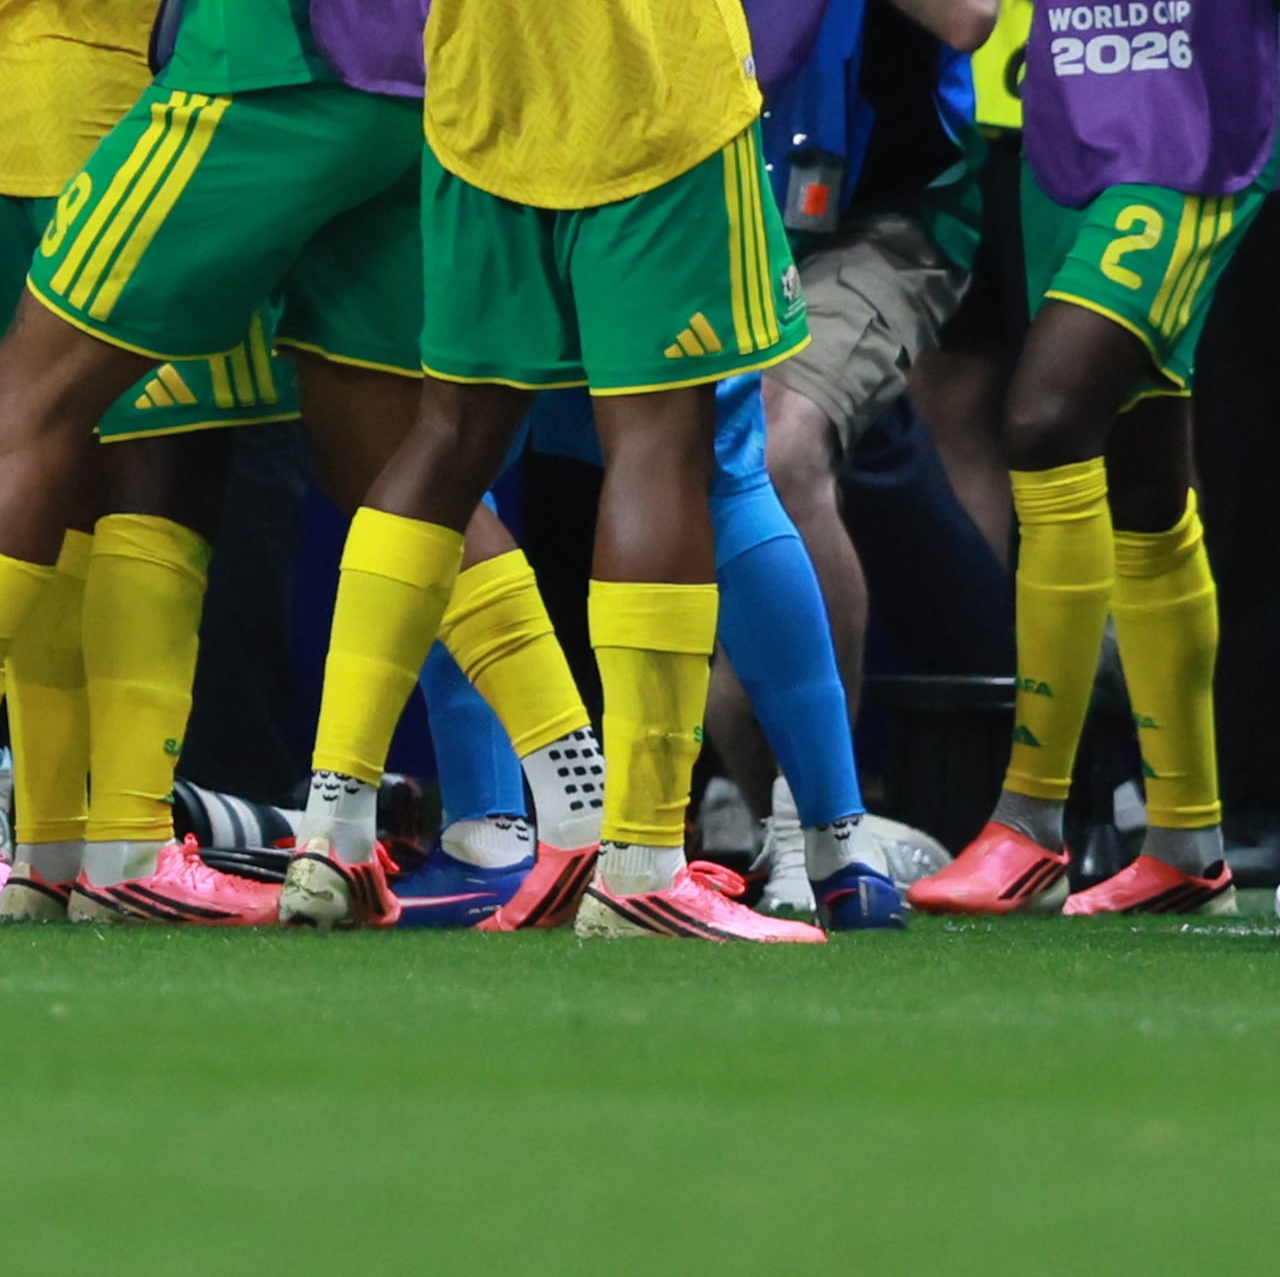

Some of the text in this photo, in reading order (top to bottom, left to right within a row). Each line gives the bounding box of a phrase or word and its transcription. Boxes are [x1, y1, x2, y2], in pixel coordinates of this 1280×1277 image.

[1048, 2, 1149, 33] WORLD
[1050, 29, 1194, 77] 2026
[1100, 204, 1164, 291] 2
